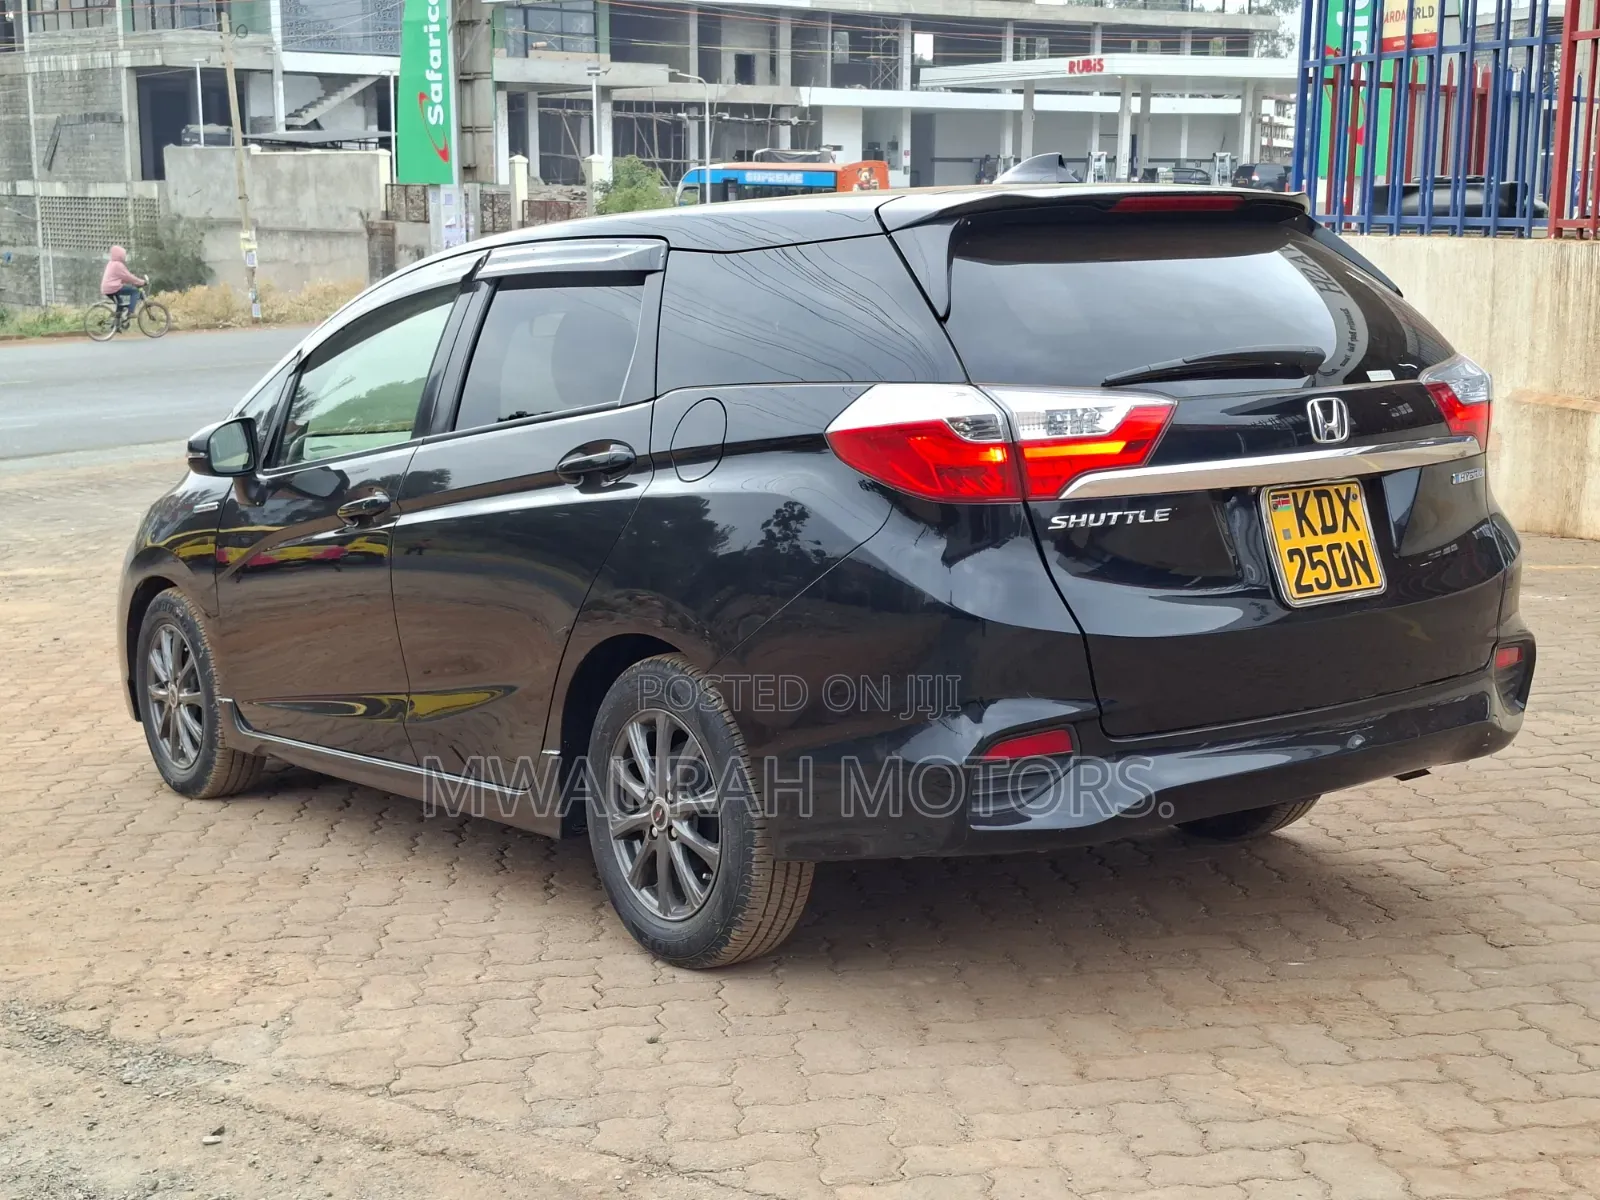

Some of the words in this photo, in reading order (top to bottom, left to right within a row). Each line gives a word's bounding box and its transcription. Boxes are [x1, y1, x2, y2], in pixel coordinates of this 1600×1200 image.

[424, 0, 444, 125] Safaric
[1048, 508, 1172, 530] SHUTTLE
[1291, 486, 1360, 538] KDX
[1287, 540, 1375, 594] 250N
